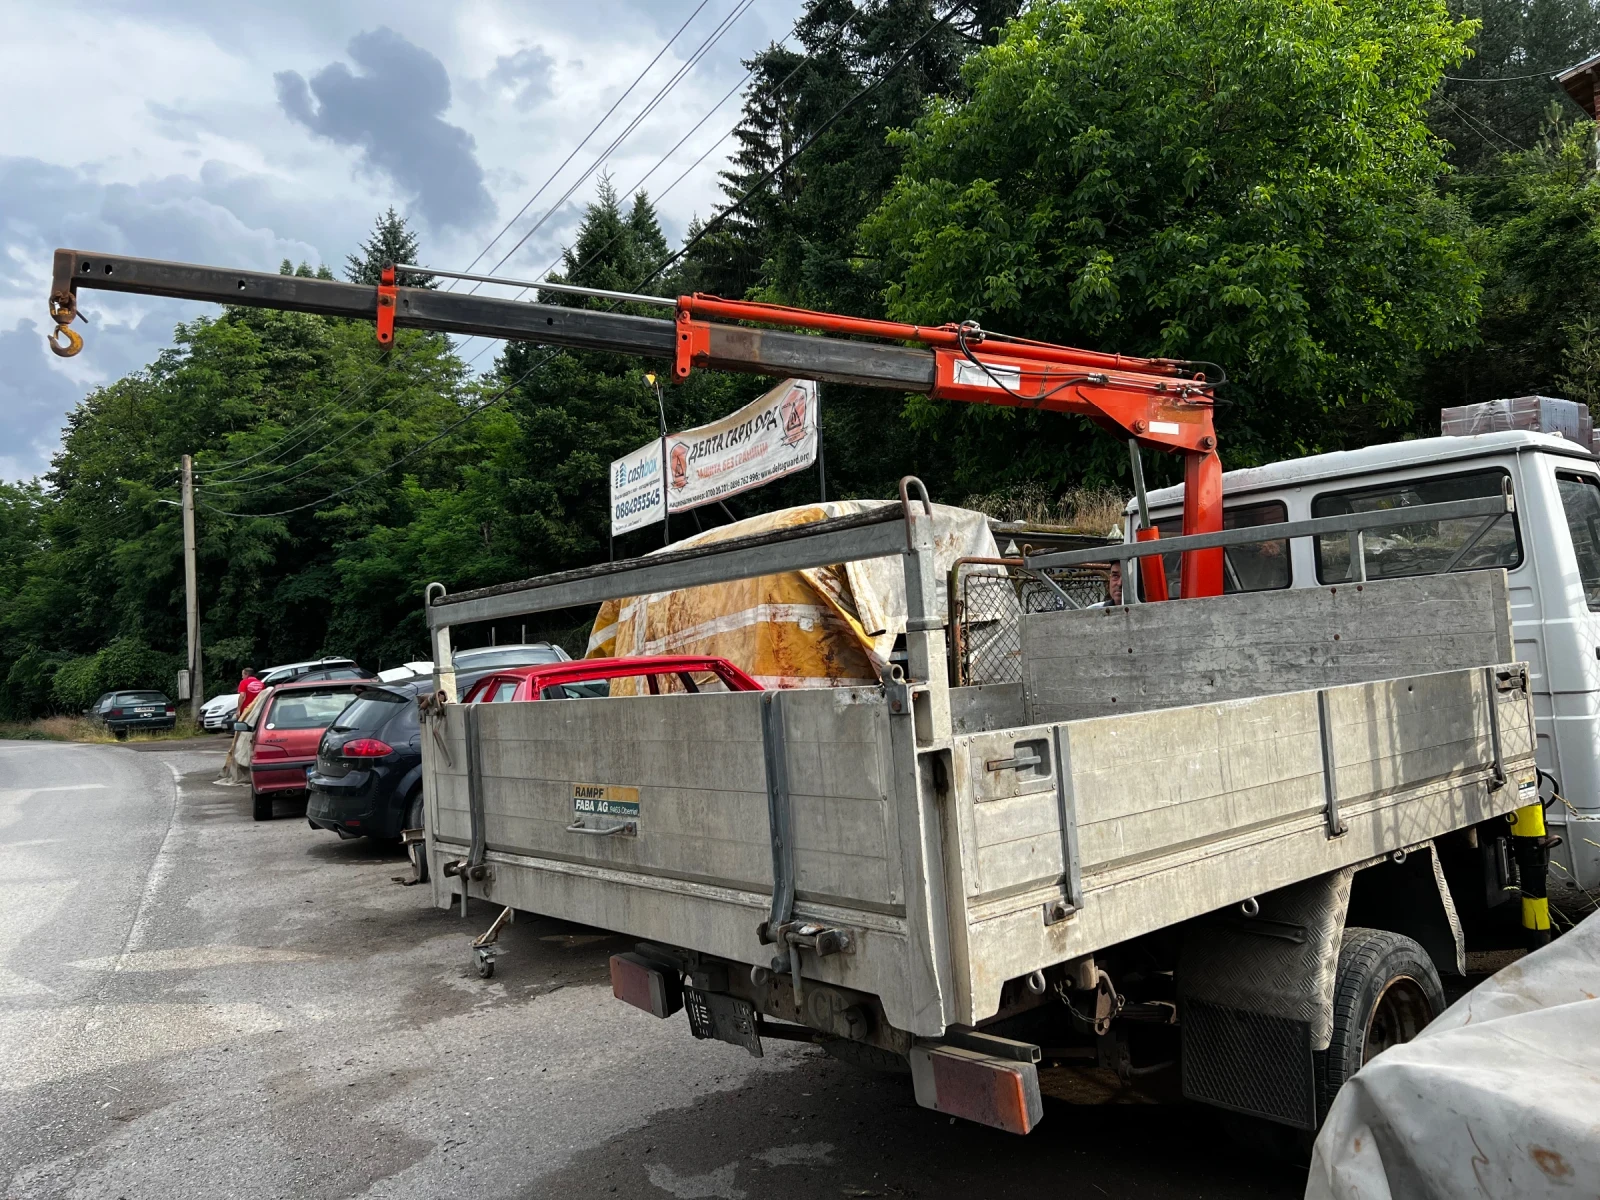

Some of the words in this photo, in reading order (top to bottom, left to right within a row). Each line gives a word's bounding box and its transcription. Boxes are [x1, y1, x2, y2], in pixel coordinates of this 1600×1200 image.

[688, 433, 723, 465] ДЕЛТА
[725, 420, 752, 444] ГАРД
[628, 457, 657, 483] cashbox
[575, 786, 604, 798] RAMPF
[575, 799, 595, 812] FABA
[596, 801, 608, 812] AG
